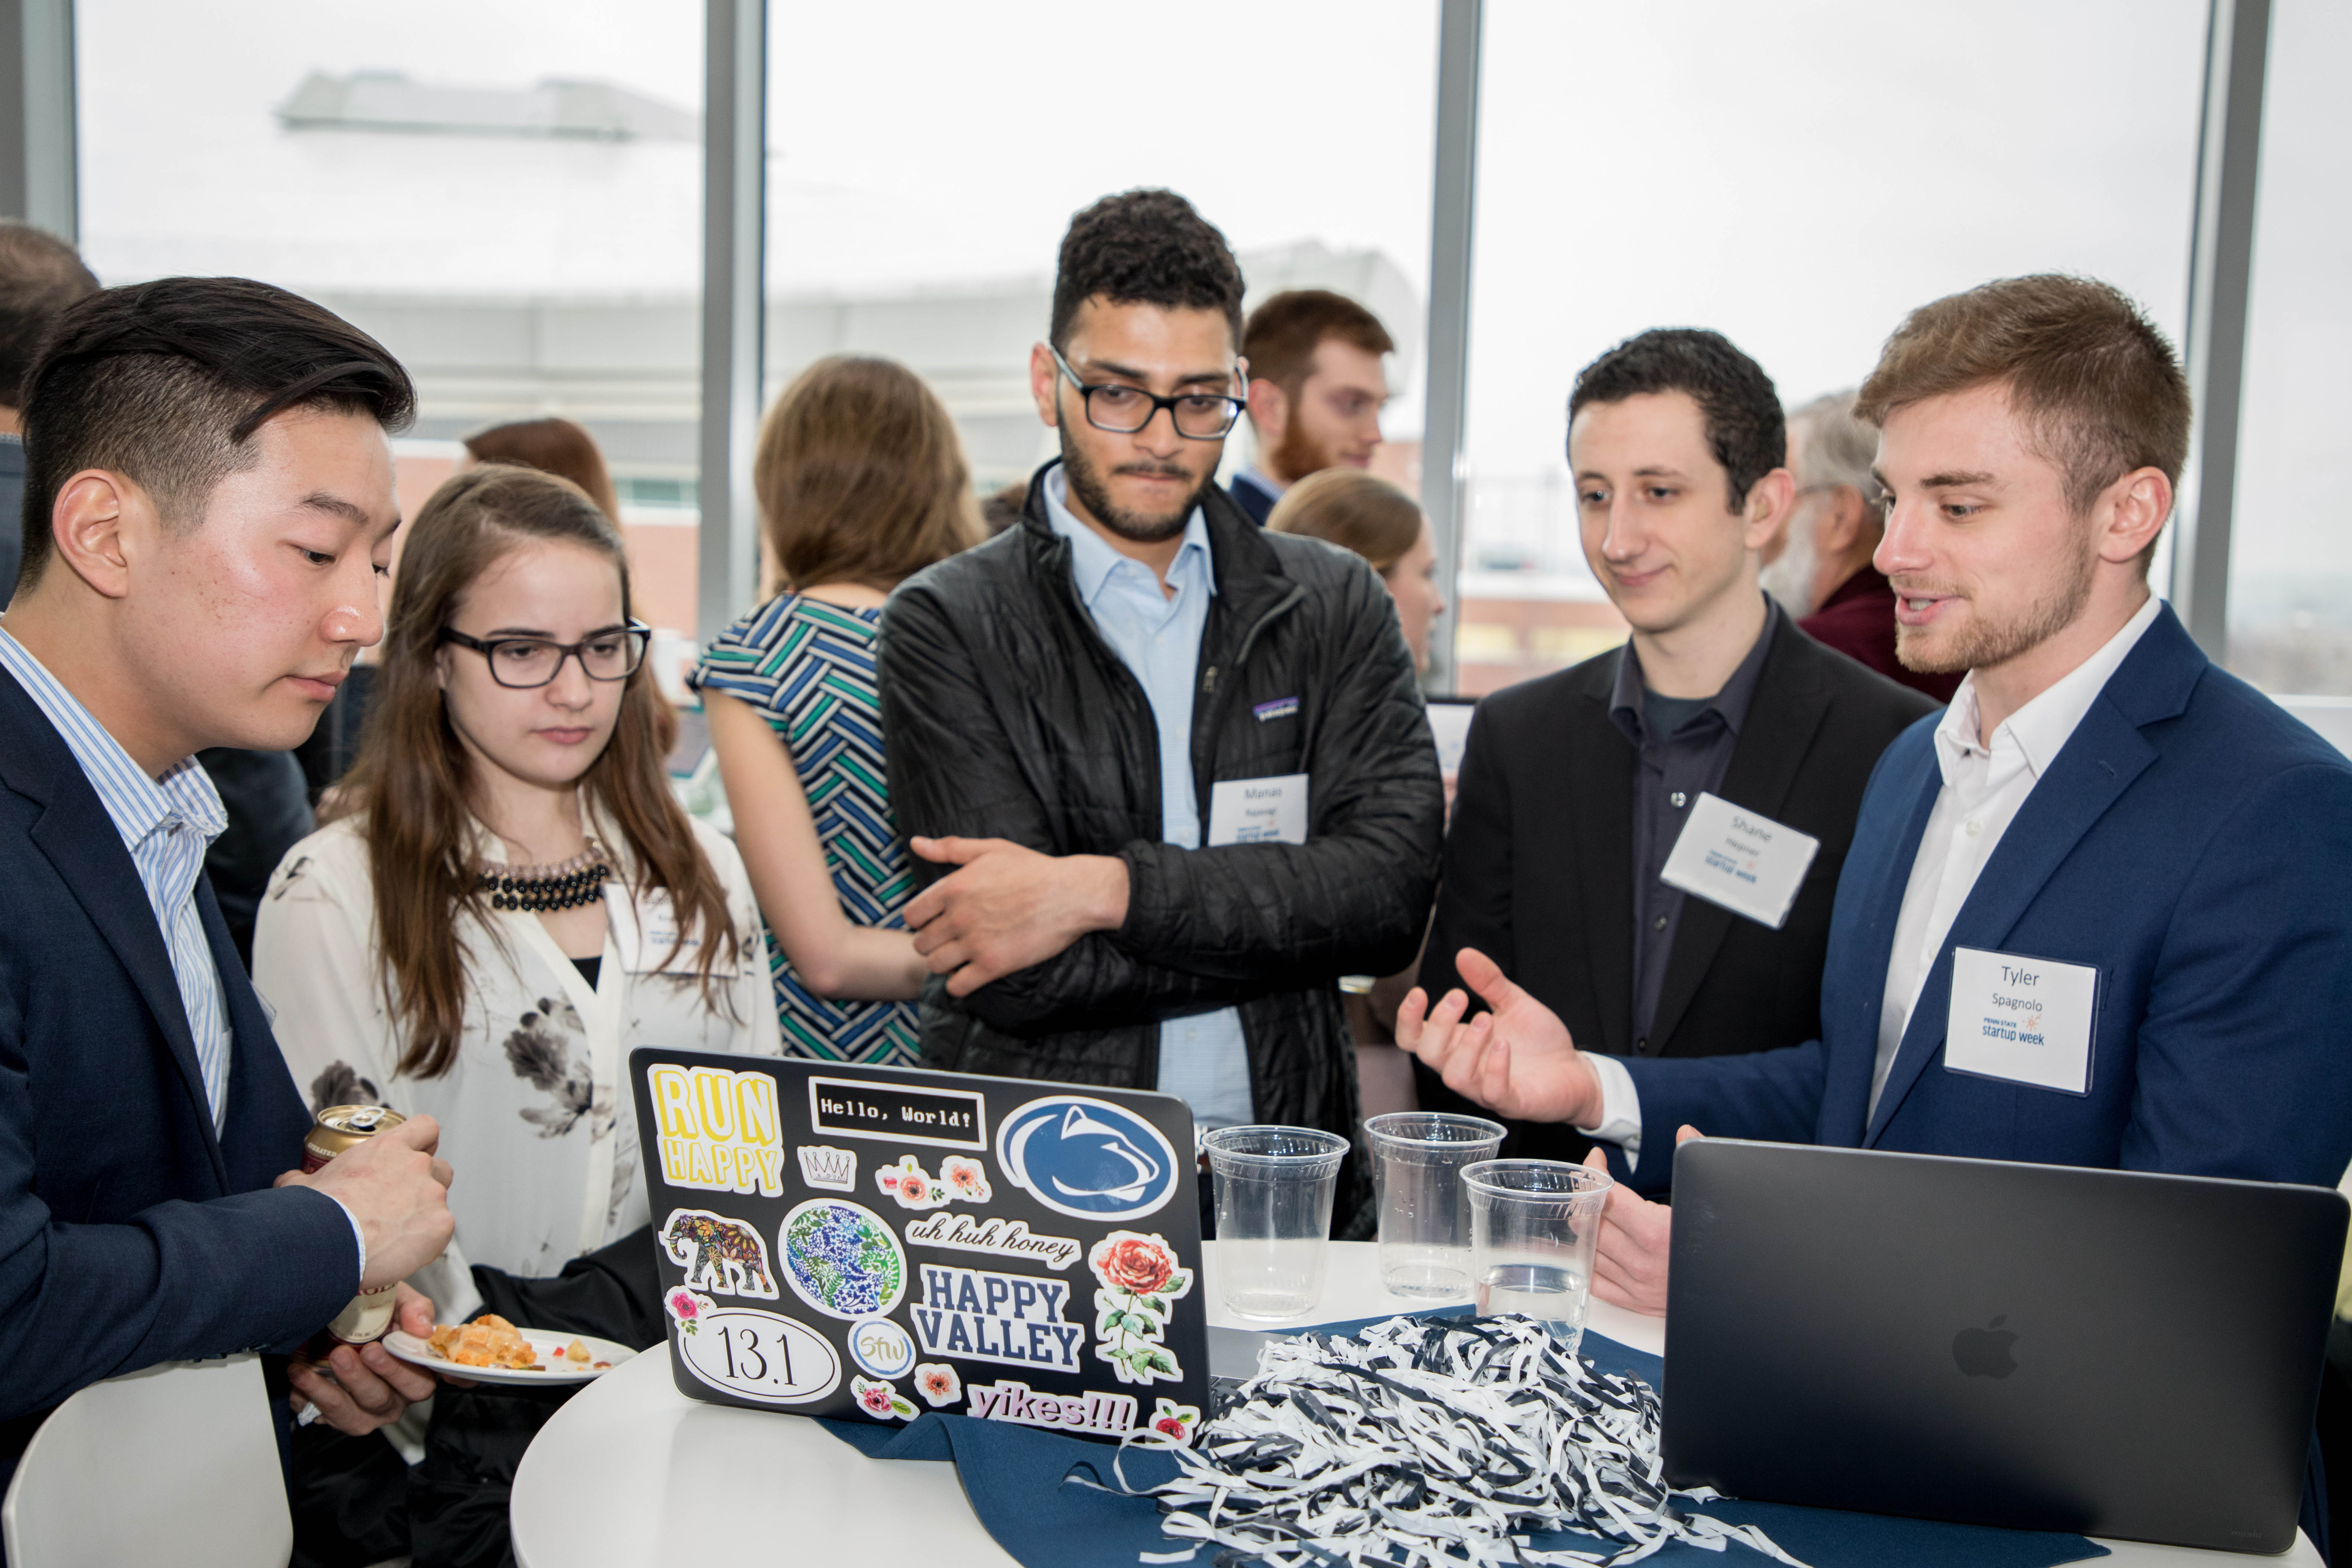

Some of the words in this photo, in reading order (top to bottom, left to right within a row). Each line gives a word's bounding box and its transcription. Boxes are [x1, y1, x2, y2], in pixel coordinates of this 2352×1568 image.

[2002, 966, 2040, 986] Tyler
[1983, 1017, 2000, 1025] PENN
[2001, 1020, 2017, 1028] STATE
[1992, 992, 2042, 1012] Spagnolo
[1982, 1025, 2016, 1041] startup
[2019, 1032, 2044, 1046] week
[654, 1070, 776, 1146] RUN
[820, 1098, 888, 1120] Hello,
[901, 1106, 971, 1128] World!
[663, 1139, 778, 1190] HAPPY
[911, 1217, 946, 1240] uh
[947, 1220, 1000, 1246] huh
[1001, 1227, 1075, 1263] honey
[926, 1269, 1063, 1324] HAPPY
[718, 1325, 797, 1386] 13.1
[916, 1308, 1079, 1366] VALLEY
[973, 1385, 1131, 1431] yikes!!!
